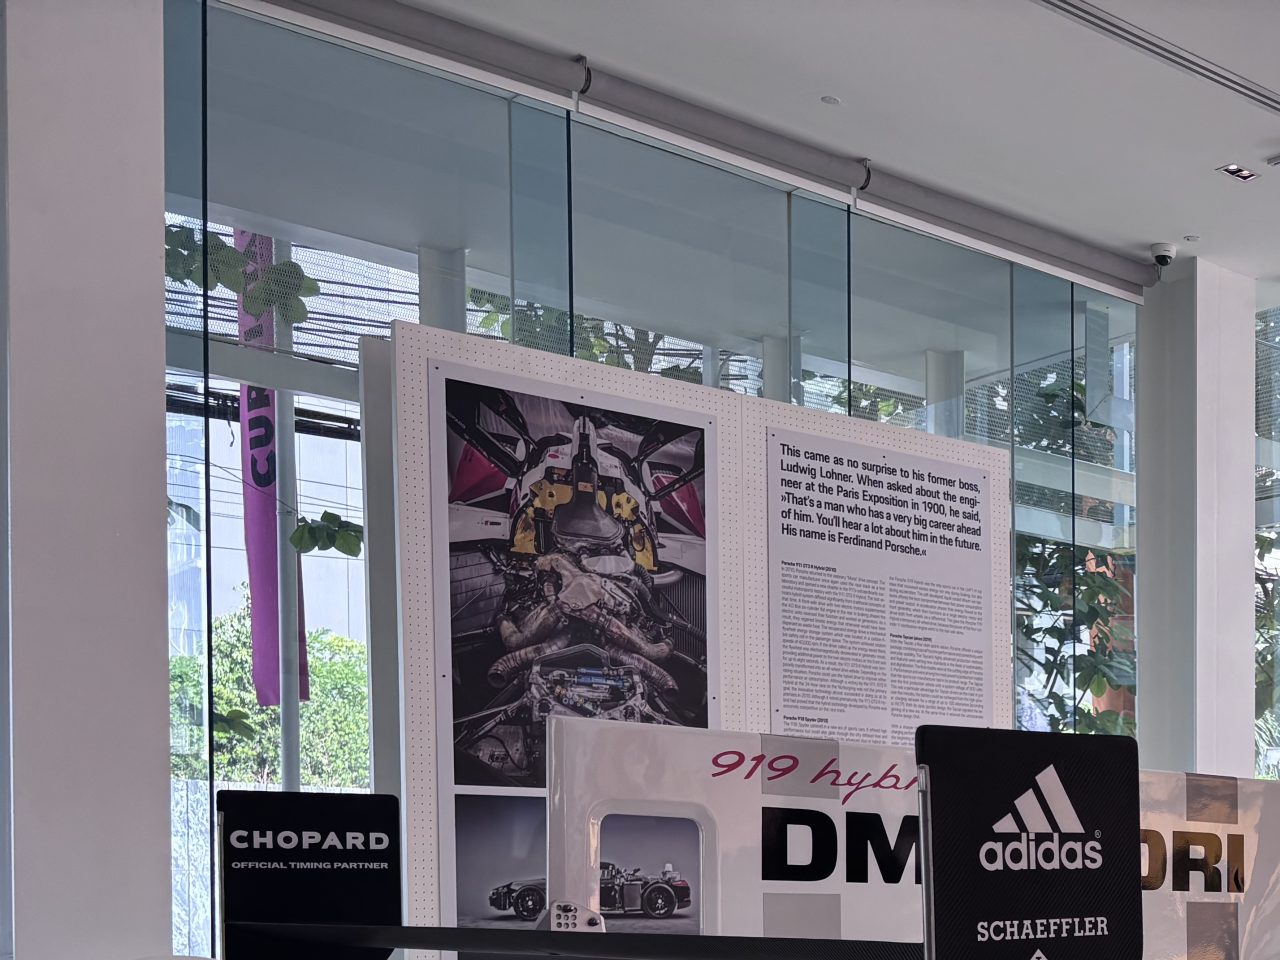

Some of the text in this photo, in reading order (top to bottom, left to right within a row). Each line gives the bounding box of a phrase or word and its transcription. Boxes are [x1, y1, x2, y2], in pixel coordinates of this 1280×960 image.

[780, 443, 981, 494] This came as no surprise to his former boss,
[780, 459, 981, 508] Ludwig Lohner. When asked about the engi-
[781, 478, 981, 523] neer at the Paris Exposition in 1900, he said,
[816, 500, 822, 509] a
[824, 501, 845, 513] man
[847, 503, 866, 517] who
[868, 505, 884, 520] has
[886, 512, 892, 521] a
[893, 513, 912, 526] very
[913, 515, 928, 529] big
[929, 519, 955, 533] career
[957, 522, 981, 537] ahead
[781, 509, 797, 520] of
[799, 511, 814, 523] him.
[842, 515, 862, 531] hear
[864, 522, 870, 532] a
[871, 521, 883, 535] lot
[885, 524, 910, 540] about
[911, 528, 929, 543] him
[929, 531, 938, 543] in
[939, 532, 953, 546] the
[955, 537, 982, 551] future.
[781, 523, 797, 537] His
[799, 528, 826, 542] name
[828, 529, 836, 542] is
[838, 532, 883, 550] Ferdinand
[711, 750, 918, 806] 919 hybr
[229, 829, 390, 850] CHOPARD
[761, 806, 922, 884] DM
[231, 861, 288, 869] OFFICIAL
[288, 861, 332, 869] TIMING
[976, 916, 1109, 942] SCHAEFFLER
